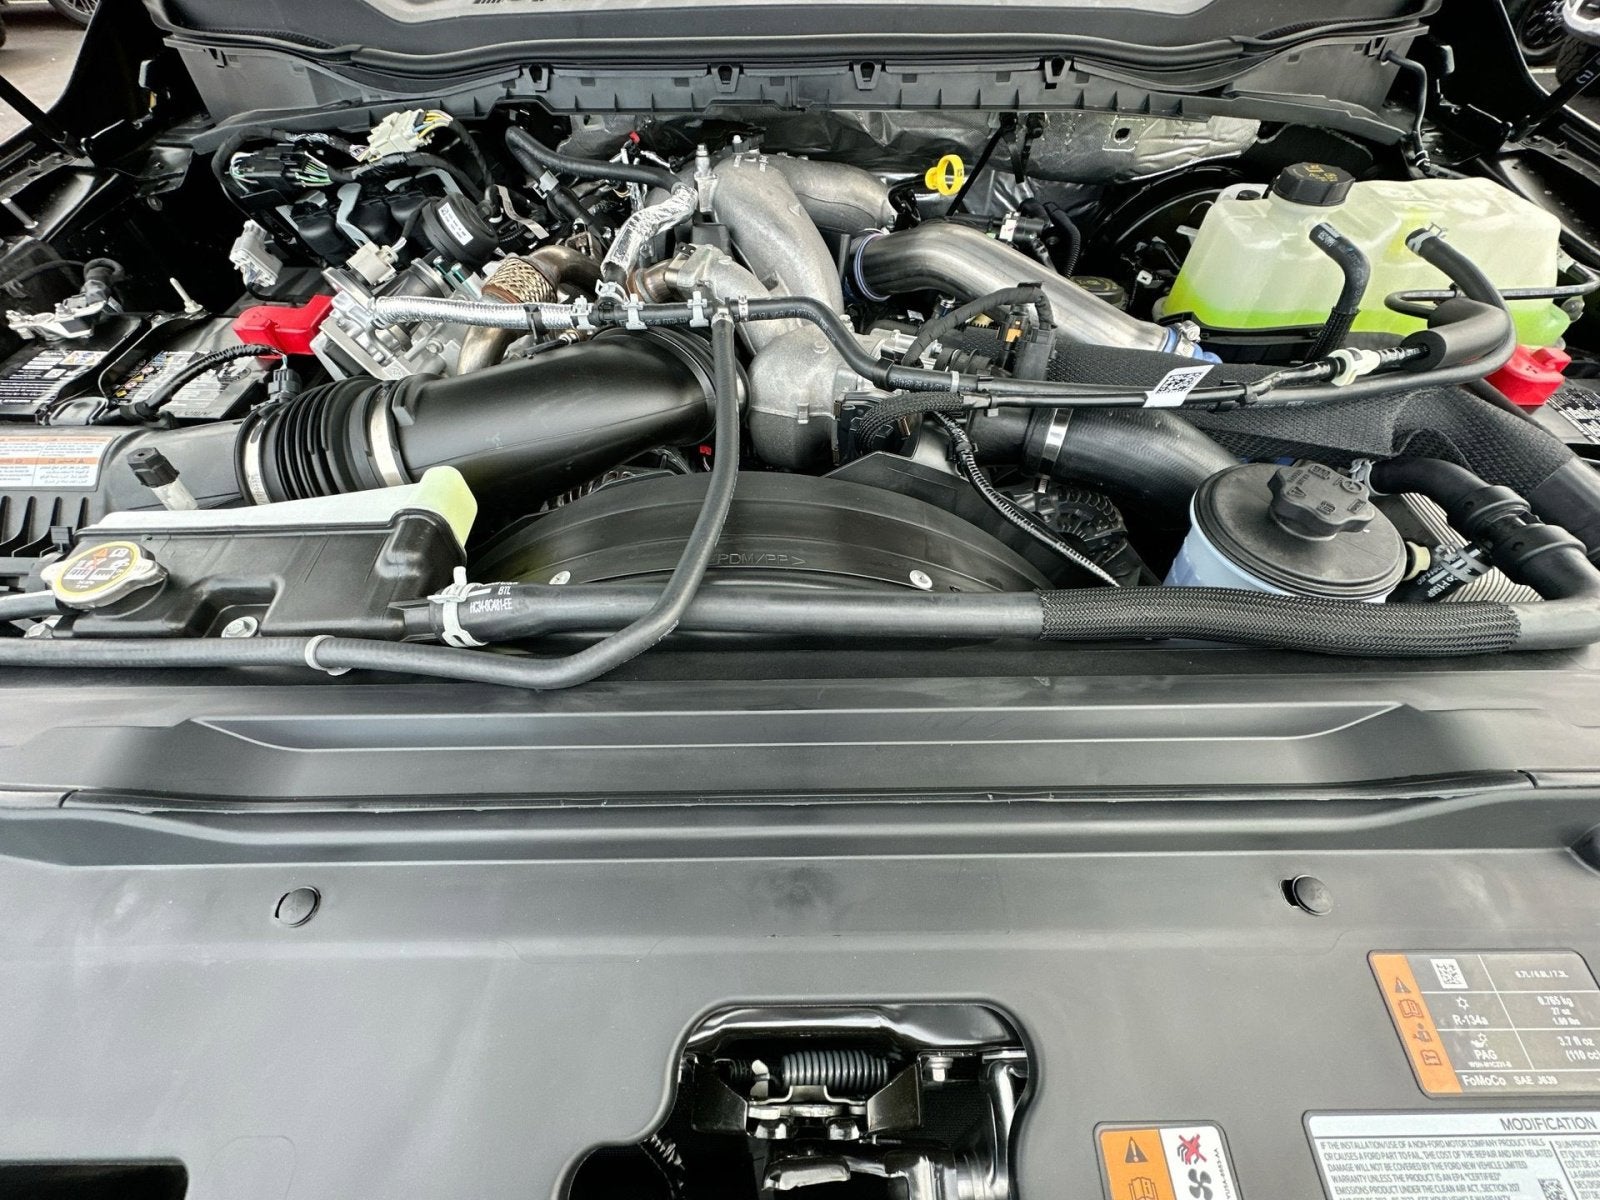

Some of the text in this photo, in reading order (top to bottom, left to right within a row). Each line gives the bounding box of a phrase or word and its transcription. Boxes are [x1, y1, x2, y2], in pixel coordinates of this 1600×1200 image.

[1560, 996, 1574, 1008] kg
[1452, 1014, 1489, 1026] R-134a
[1557, 1035, 1572, 1047] 3.7
[1582, 1037, 1595, 1047] oz
[1473, 1049, 1498, 1060] PAG
[1461, 1074, 1558, 1087] FoMoCo SAE J639
[1500, 1117, 1597, 1131] MODIFICATION
